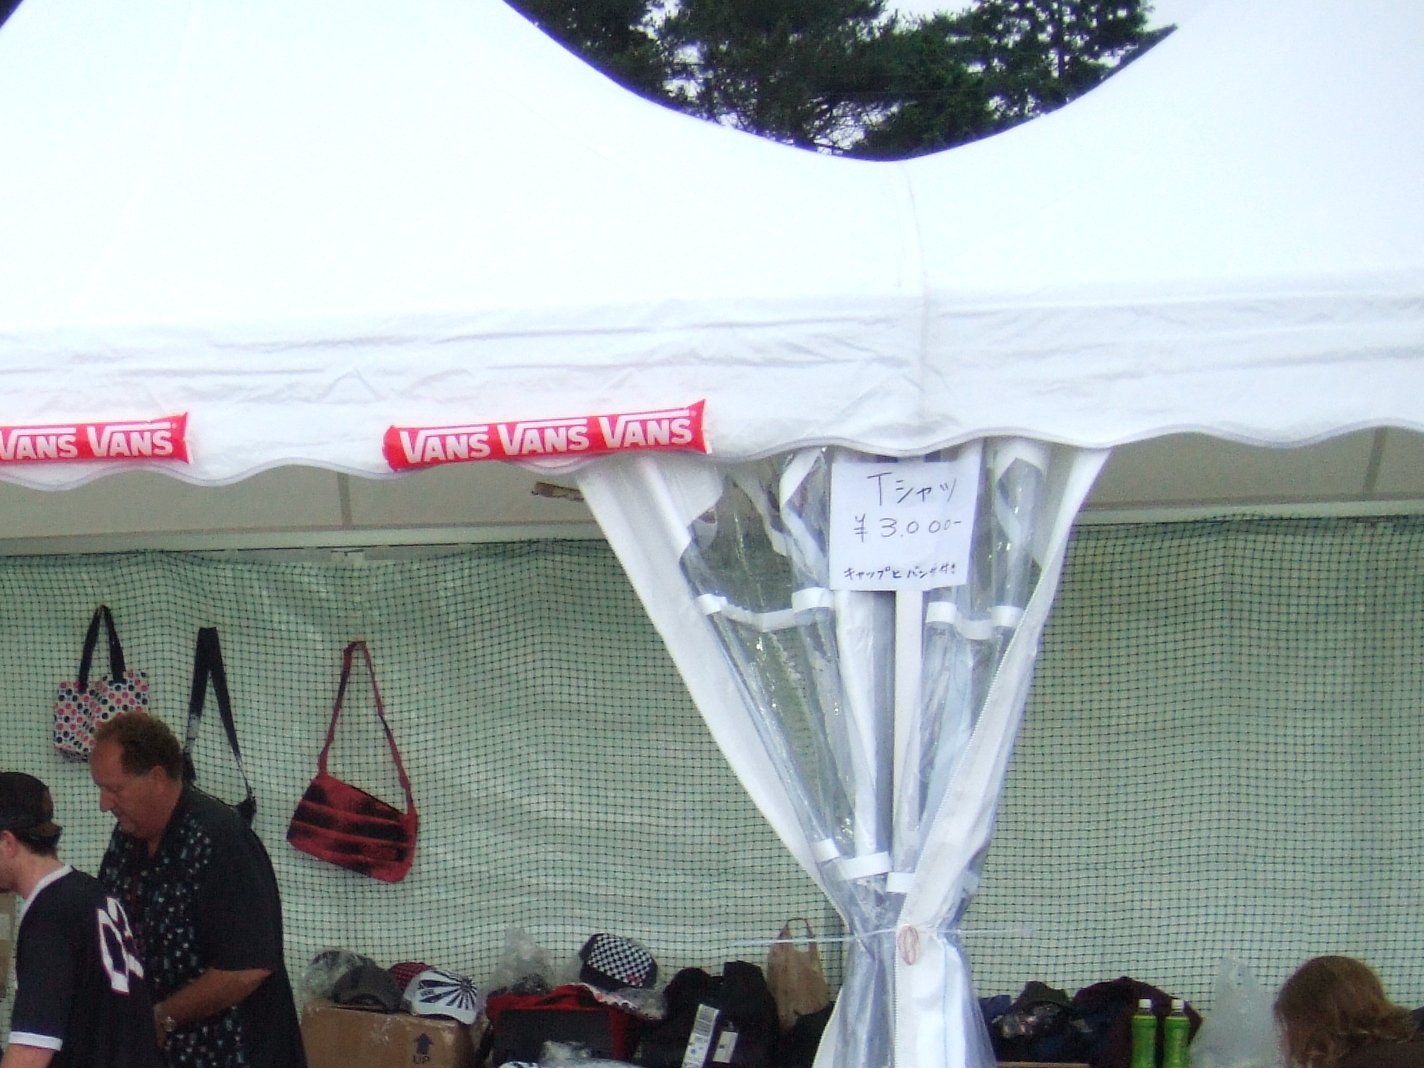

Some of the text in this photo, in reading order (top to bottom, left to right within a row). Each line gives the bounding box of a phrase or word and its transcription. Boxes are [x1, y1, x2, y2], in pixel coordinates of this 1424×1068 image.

[87, 422, 173, 458] VANS
[400, 409, 692, 464] VANS VANS VANS
[866, 472, 957, 506] Tシャツ
